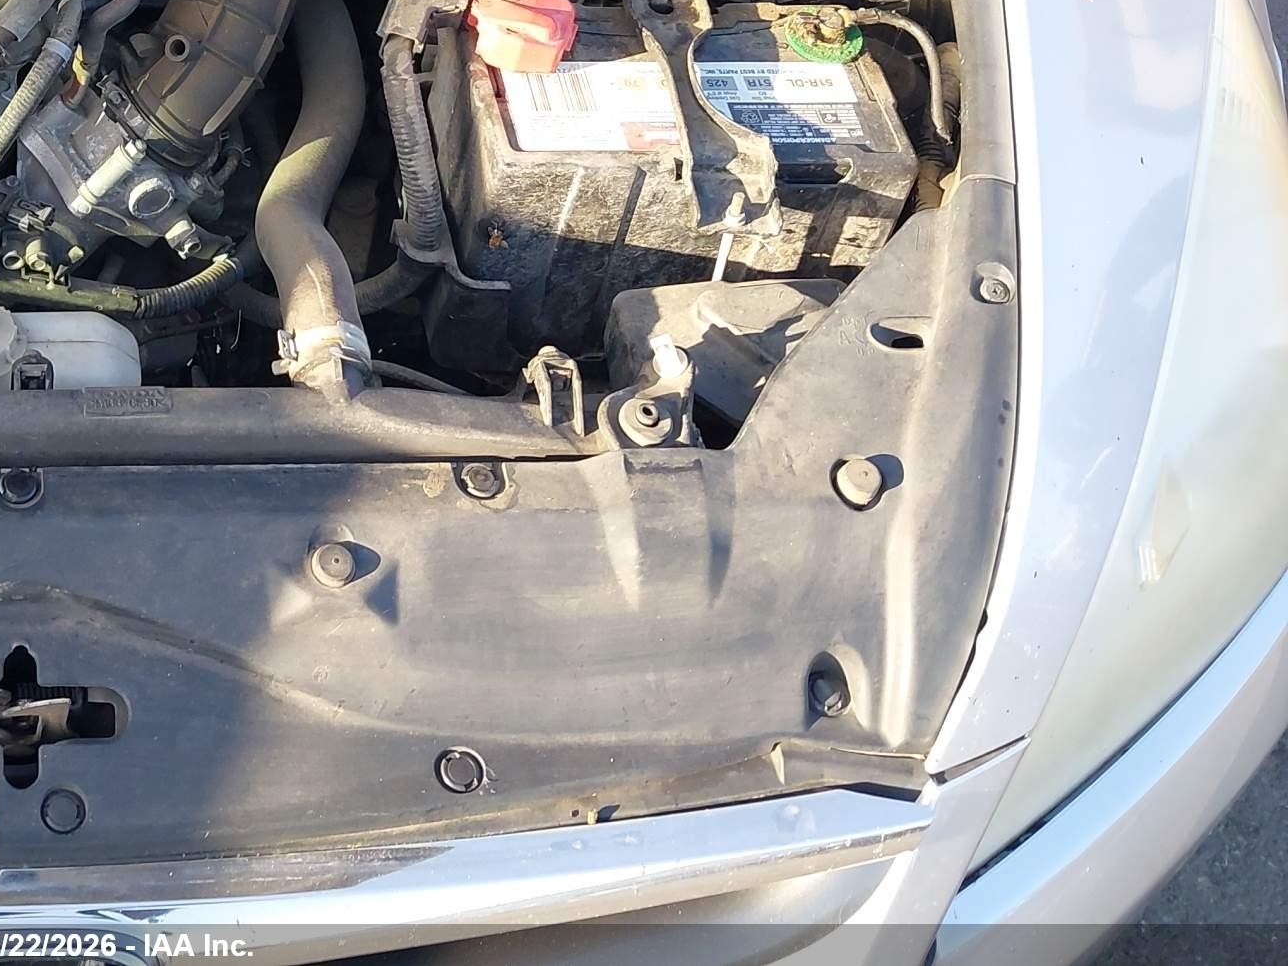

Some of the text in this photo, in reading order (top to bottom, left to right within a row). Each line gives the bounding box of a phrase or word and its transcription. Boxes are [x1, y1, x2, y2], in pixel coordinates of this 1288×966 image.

[705, 79, 729, 88] 425
[747, 79, 772, 88] 51R
[785, 78, 834, 88] 51R-DL
